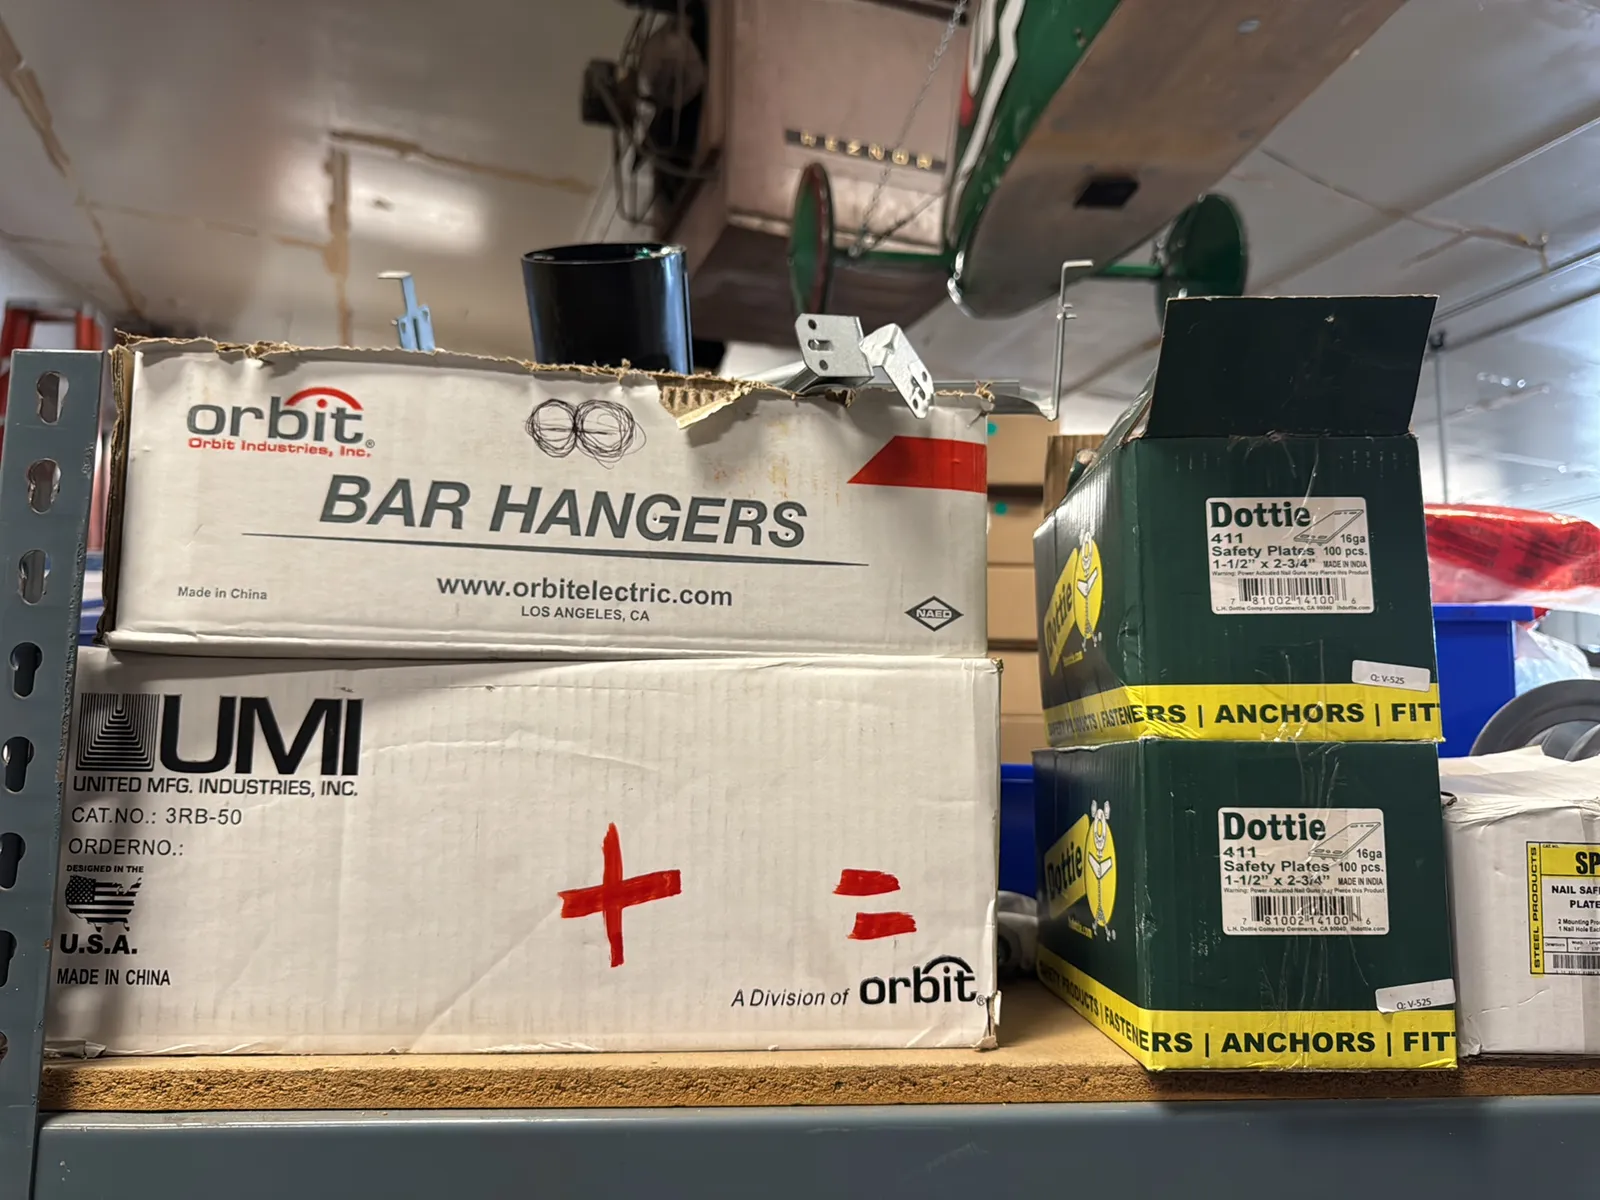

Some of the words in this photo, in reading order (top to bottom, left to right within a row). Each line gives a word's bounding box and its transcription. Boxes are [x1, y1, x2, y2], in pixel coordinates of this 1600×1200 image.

[188, 438, 235, 450] Orbit
[241, 440, 334, 457] Industries,
[340, 445, 371, 458] Inc.
[320, 474, 471, 530] BAR
[489, 484, 808, 548] HANGERS
[1210, 501, 1311, 528] Dottie
[1211, 533, 1243, 544] 411
[1341, 534, 1366, 546] 16ga
[1212, 546, 1262, 558] Safety
[1268, 546, 1315, 557] Plates
[1324, 547, 1342, 556] 100
[1345, 548, 1368, 558] pcs.
[1260, 561, 1269, 569] x
[1323, 560, 1342, 568] MADE
[1343, 560, 1349, 568] IN
[1350, 560, 1367, 568] INDIA
[178, 586, 211, 599] Made
[215, 587, 227, 599] in
[231, 588, 268, 600] China
[437, 577, 733, 606] www.orbitelectric.com
[1252, 596, 1291, 605] 81002
[1296, 596, 1335, 605] 14100
[521, 605, 551, 618] LOS
[554, 606, 626, 622] ANGELES,
[630, 609, 650, 622] CA
[1370, 673, 1380, 682] Q:
[1381, 675, 1405, 684] V-525
[1101, 704, 1186, 729] FASTENERS
[1214, 702, 1365, 723] ANCHORS
[160, 694, 364, 776] UMI
[73, 776, 142, 793] UNITED
[148, 777, 193, 794] MFG.
[199, 778, 315, 798] INDUSTRIES,
[321, 780, 359, 797] INC.
[165, 808, 242, 826] 3RB-50
[1222, 812, 1326, 841] Dottie
[1223, 846, 1256, 858] 411
[1357, 848, 1383, 861] 16ga
[66, 864, 112, 873] DESIGNED
[114, 865, 124, 873] IN
[126, 865, 144, 873] THE
[1047, 841, 1083, 900] Dottie
[1224, 860, 1276, 874] Safety
[1281, 861, 1330, 872] Plates
[1339, 862, 1357, 872] 100
[1361, 863, 1384, 874] pcs.
[1273, 877, 1282, 886] x
[1338, 877, 1357, 886] MADE
[1358, 877, 1365, 886] IN
[1366, 877, 1383, 886] INDIA
[1530, 847, 1539, 922] PRODUCTS
[1551, 885, 1576, 894] NAIL
[1579, 886, 1600, 895] SAF
[1264, 916, 1304, 926] 81002
[1309, 916, 1349, 926] 14100
[1366, 917, 1371, 925] 6
[59, 933, 138, 955] U.S.A.
[1533, 926, 1541, 969] STEEL
[57, 967, 99, 985] MADE
[105, 968, 119, 985] IN
[125, 969, 171, 986] CHINA
[731, 989, 744, 1007] A
[749, 988, 825, 1007] Division
[830, 988, 850, 1006] of
[1396, 1001, 1406, 1010] Q:
[1407, 997, 1432, 1008] V-525
[1105, 1005, 1193, 1053] FASTENERS
[1221, 1031, 1376, 1053] ANCHORS
